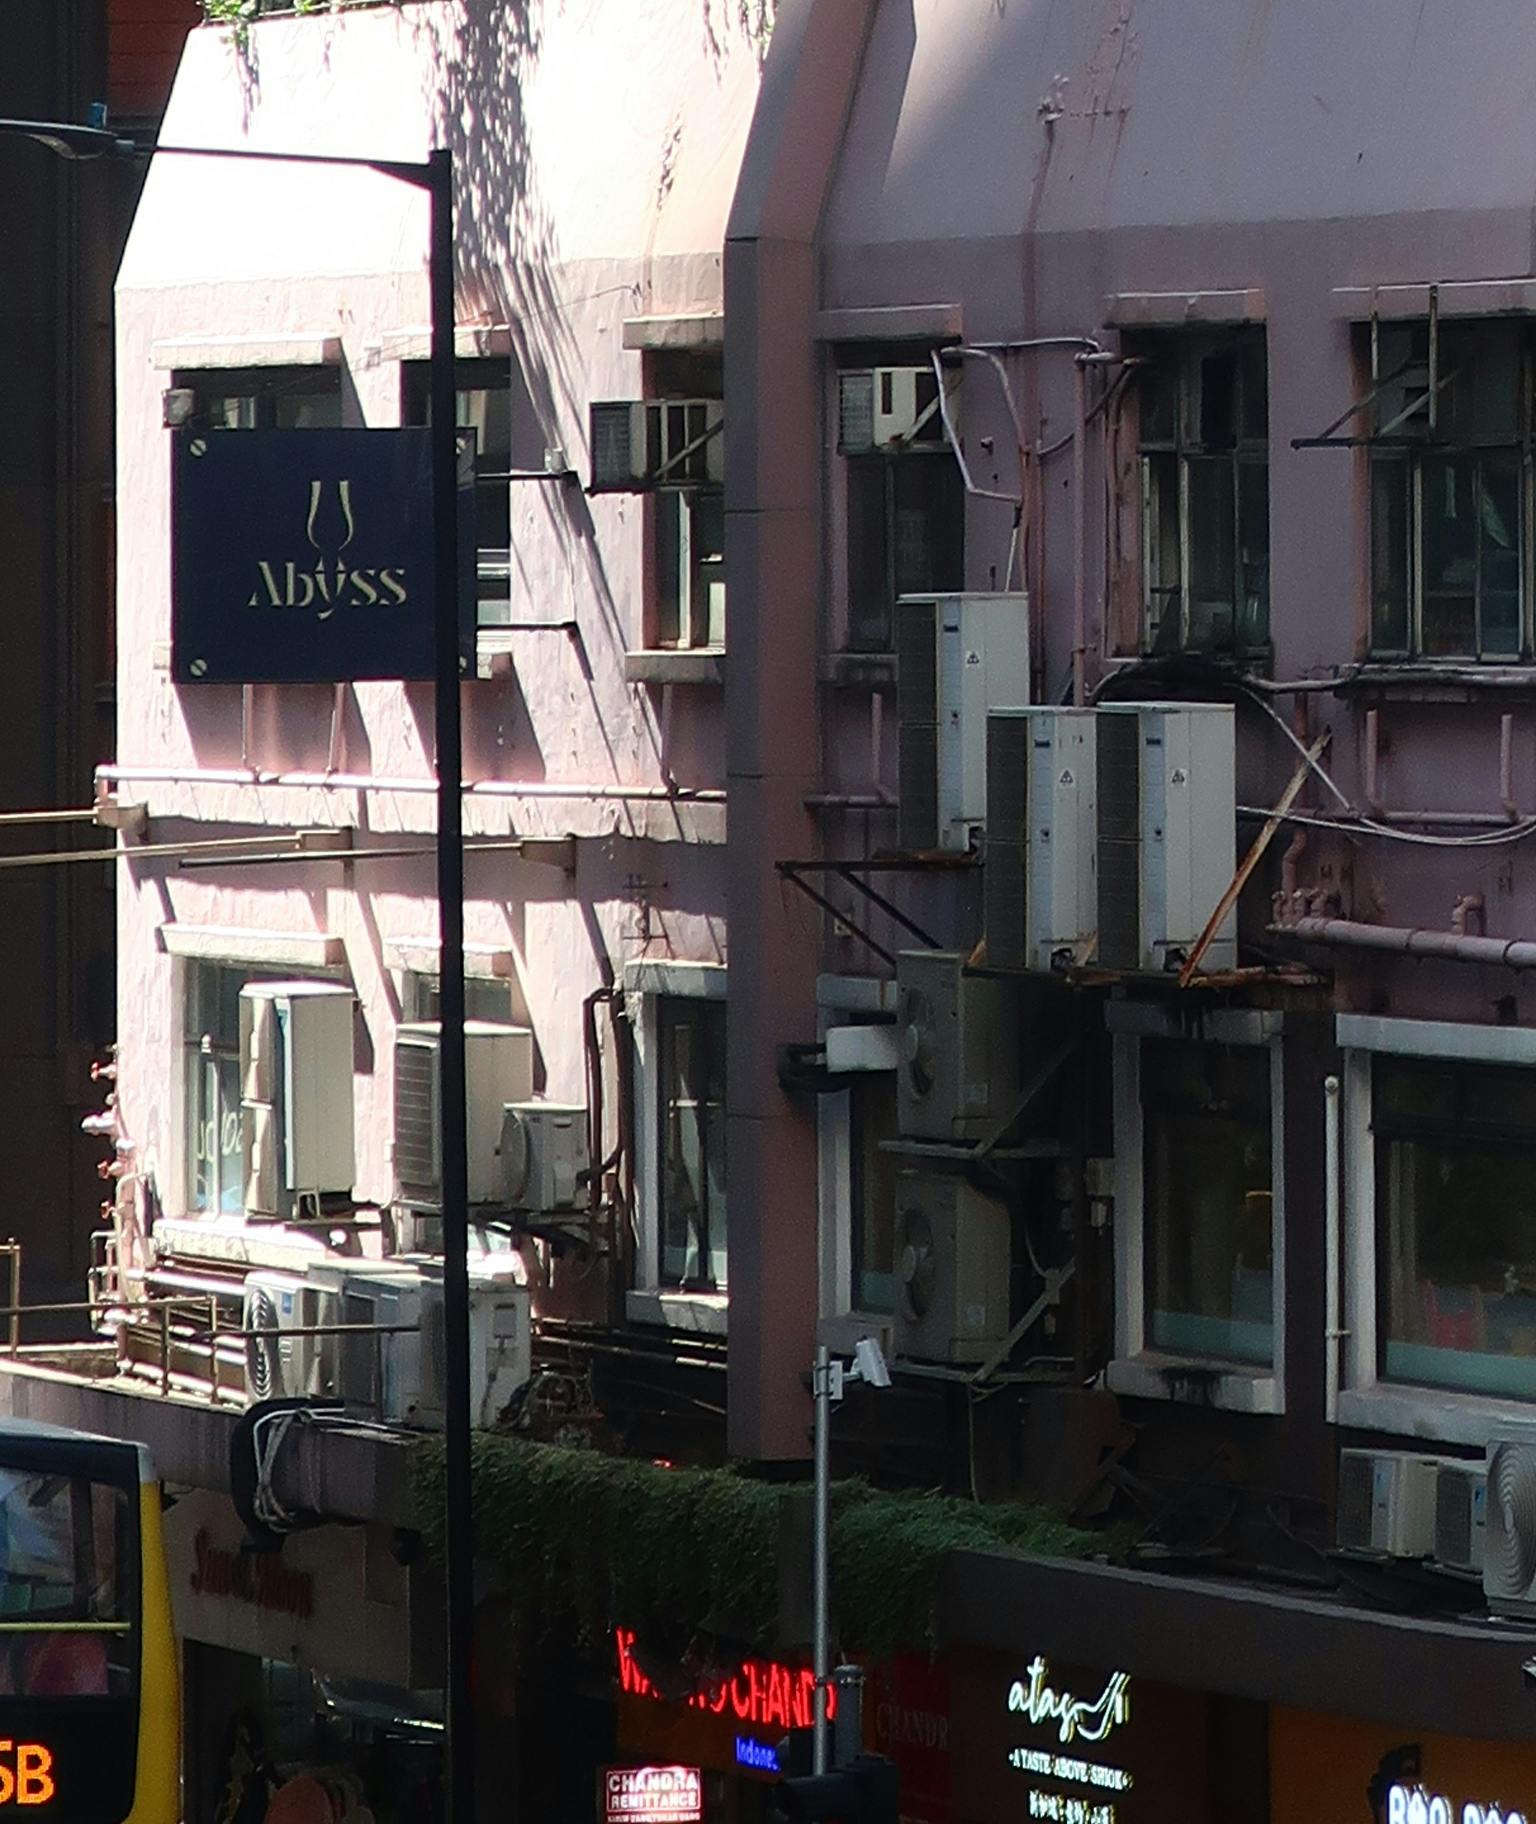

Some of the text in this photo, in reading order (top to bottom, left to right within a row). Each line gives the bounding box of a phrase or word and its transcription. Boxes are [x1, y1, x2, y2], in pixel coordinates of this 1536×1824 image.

[248, 555, 407, 620] Abyss
[609, 1772, 698, 1792] CHANDRA
[611, 1791, 697, 1809] REMITTANCE
